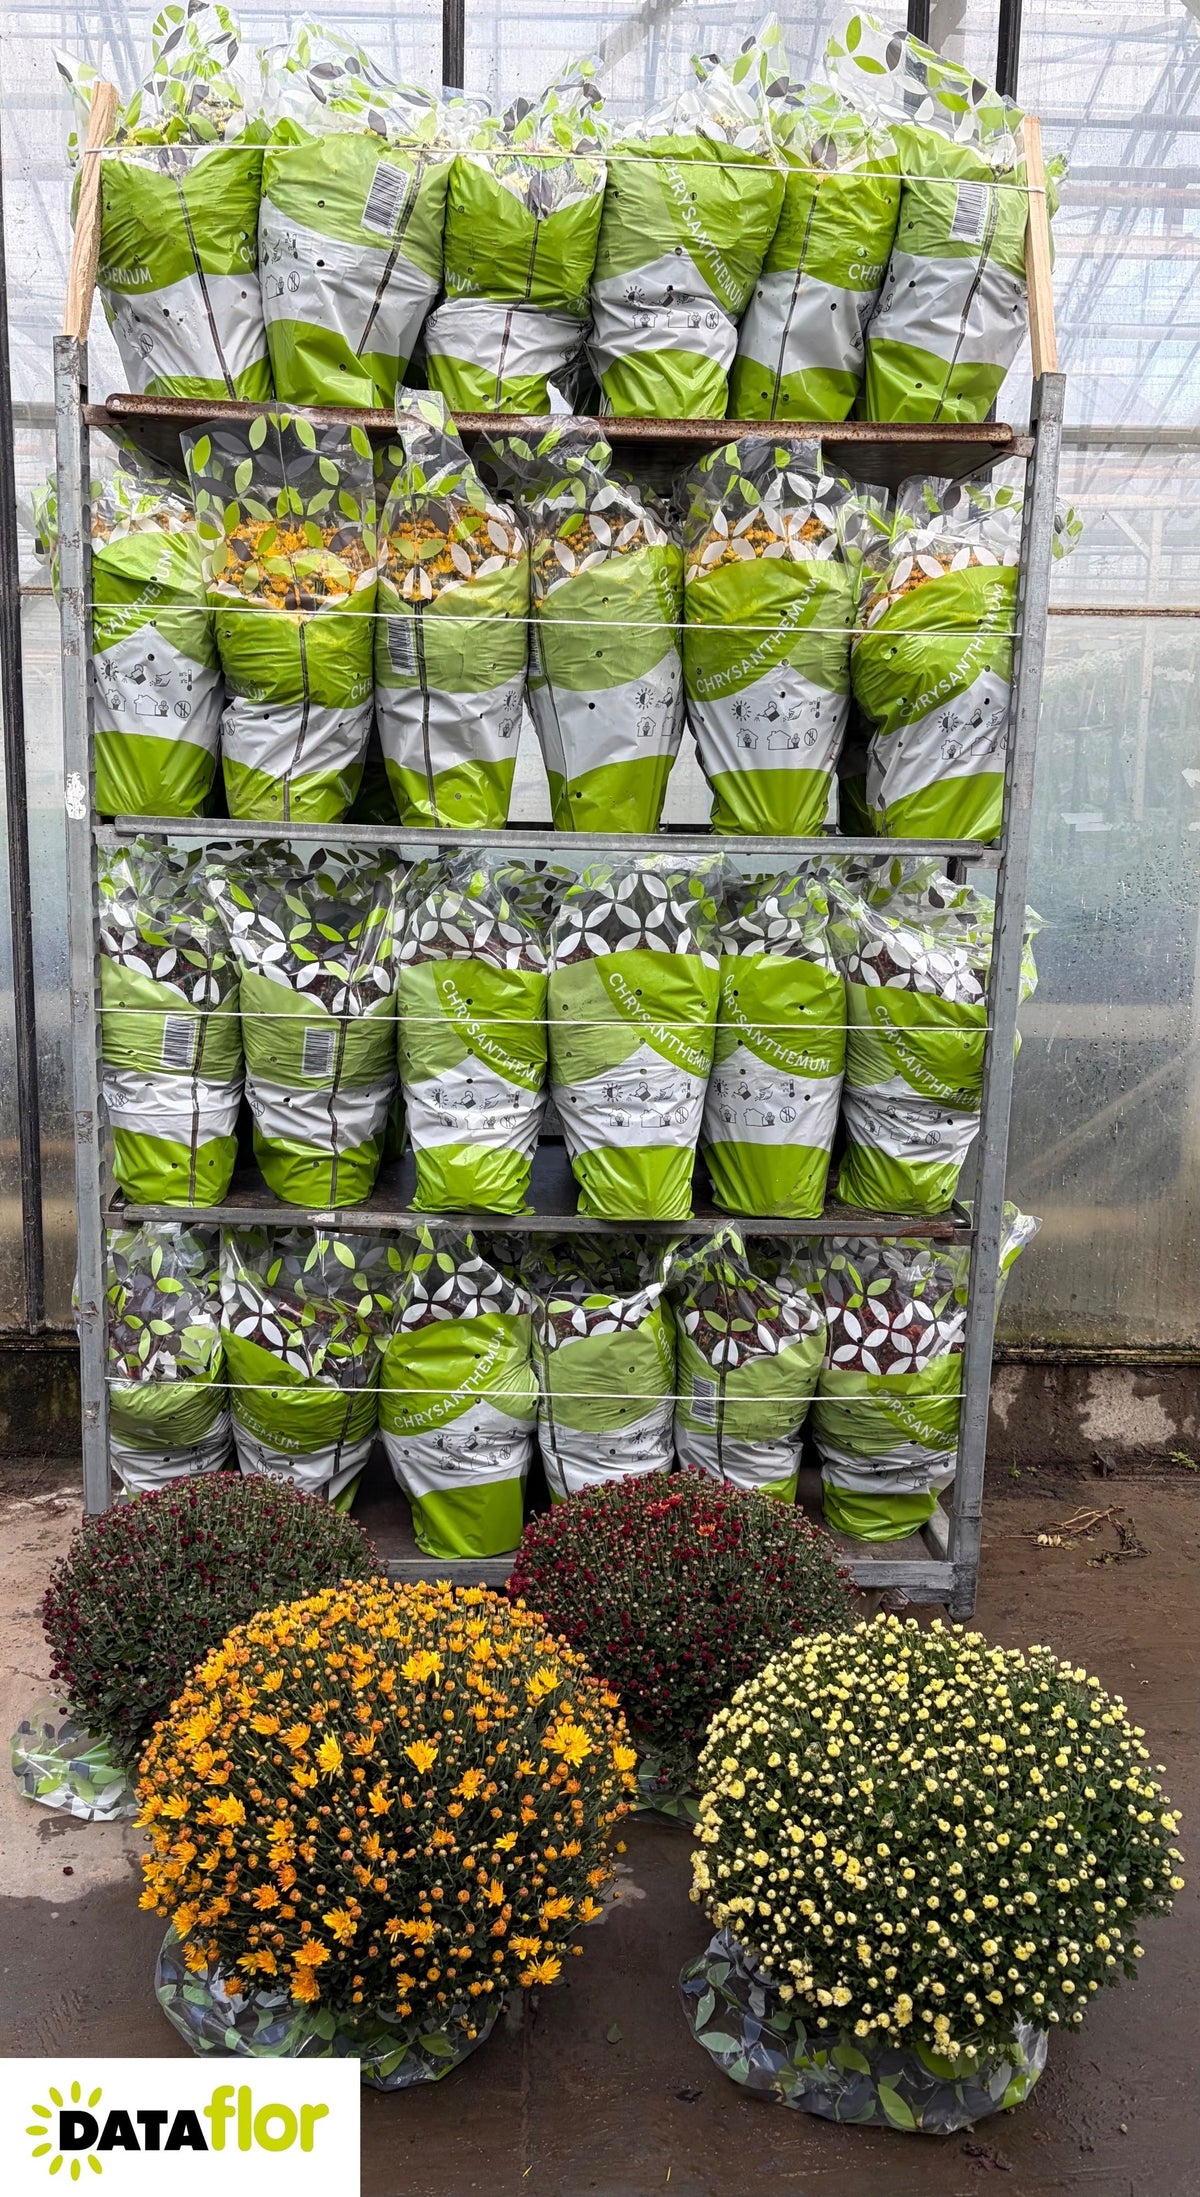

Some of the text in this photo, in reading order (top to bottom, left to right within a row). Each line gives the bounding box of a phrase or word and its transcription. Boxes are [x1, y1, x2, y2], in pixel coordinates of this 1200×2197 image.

[696, 578, 821, 693] CHRYSANTHEMUM
[723, 974, 831, 1073] CHRYSANTHEMUM
[393, 1327, 505, 1429] CHRYSANTHEMUM
